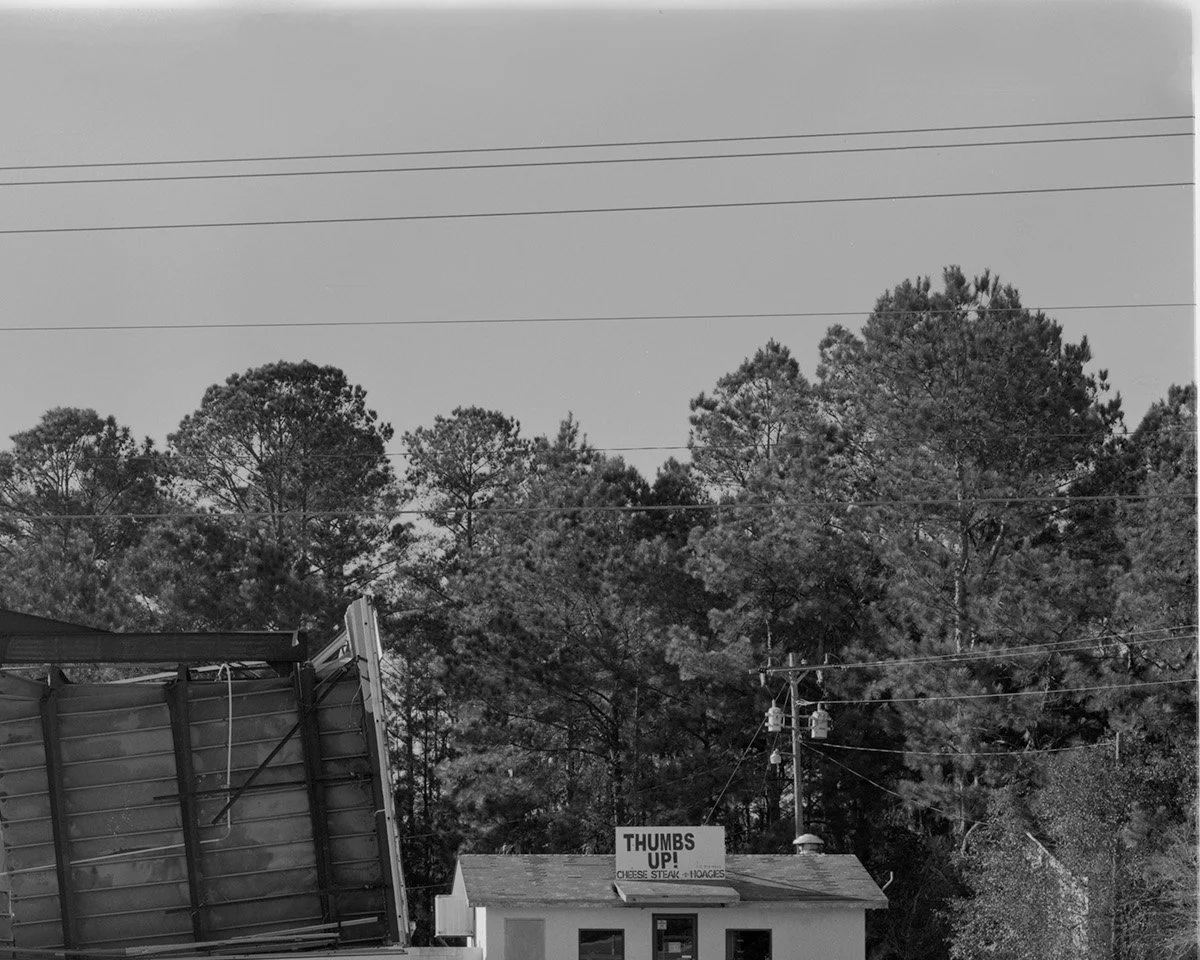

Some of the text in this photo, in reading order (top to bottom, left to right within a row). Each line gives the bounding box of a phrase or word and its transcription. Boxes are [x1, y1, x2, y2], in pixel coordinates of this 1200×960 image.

[623, 833, 695, 851] THUMBS
[648, 852, 678, 869] UP!
[616, 870, 648, 879] CHEESE
[650, 870, 680, 879] STEAK
[690, 869, 726, 879] HOAGIES
